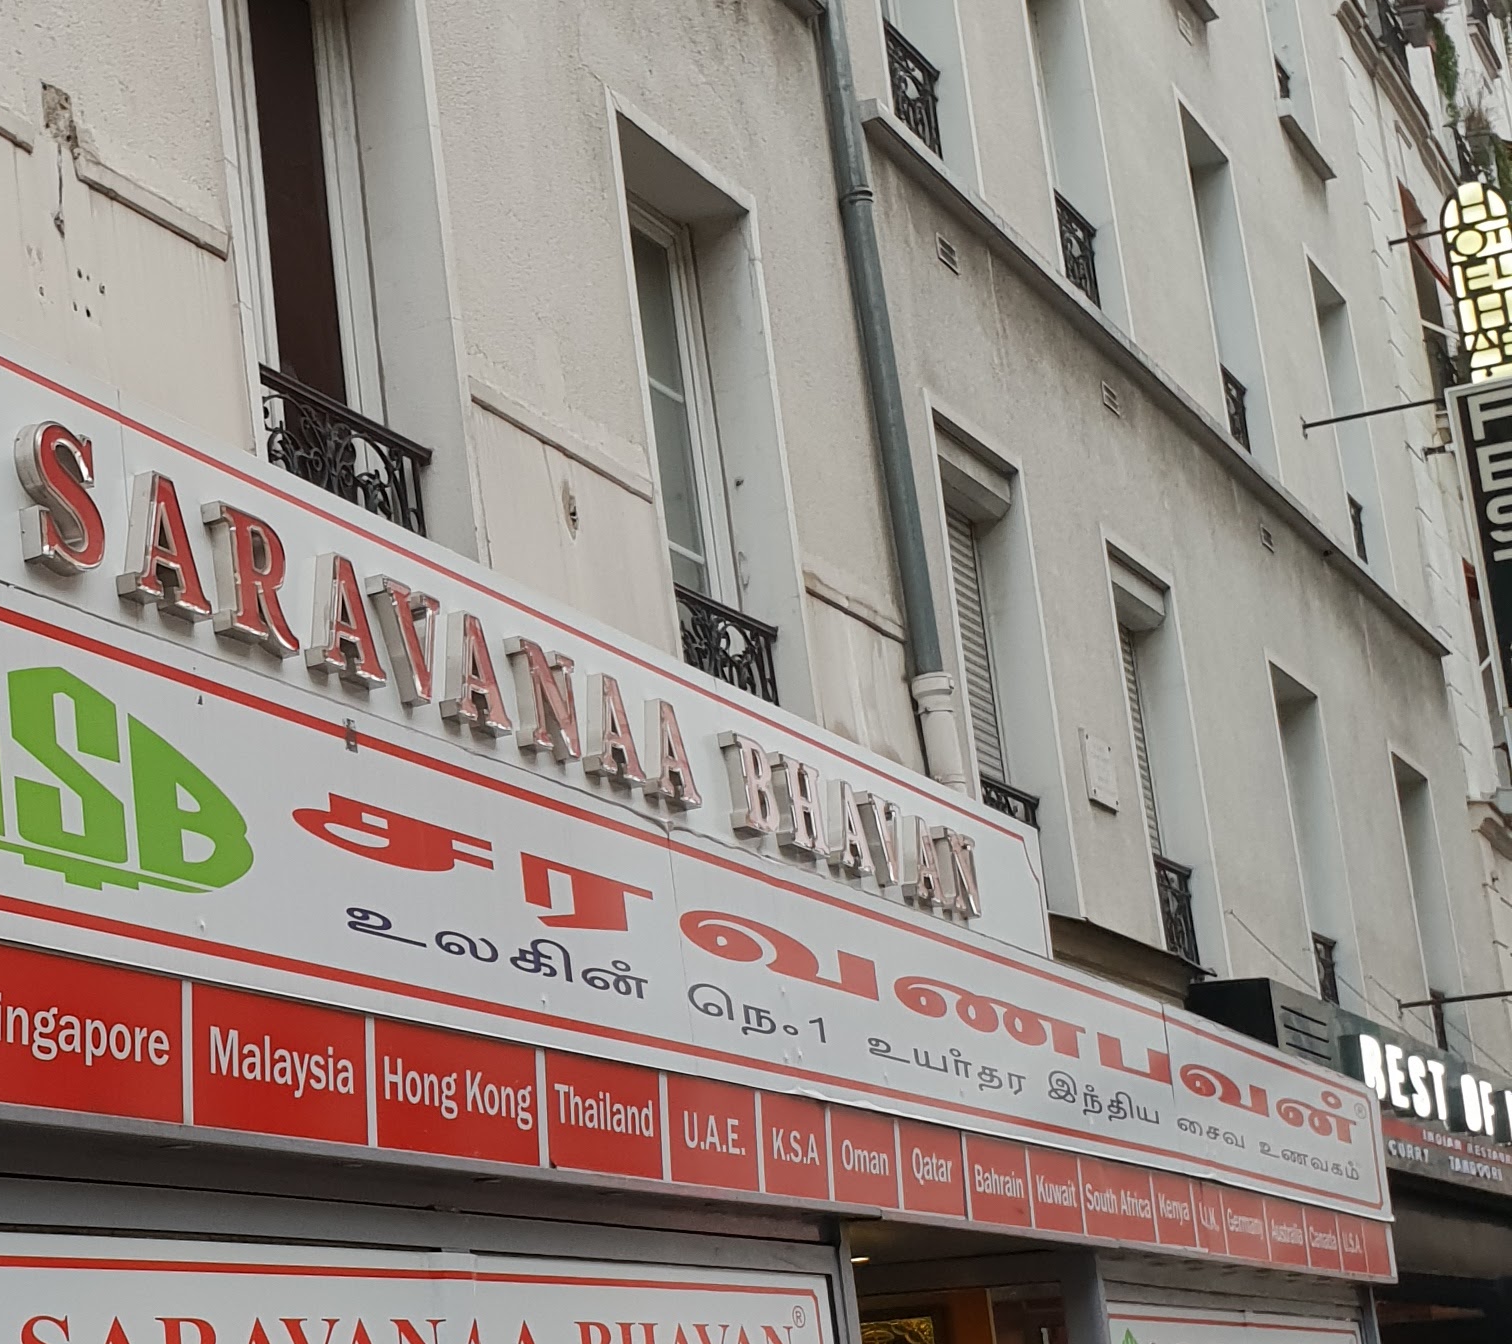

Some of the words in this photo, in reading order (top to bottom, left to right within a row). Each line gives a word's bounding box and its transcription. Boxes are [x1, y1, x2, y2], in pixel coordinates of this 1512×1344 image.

[14, 419, 702, 809] SARAVANAA
[717, 730, 982, 919] BHAVAN
[345, 906, 650, 1000] உலகின்
[208, 1025, 355, 1099] Malaysia
[383, 1055, 458, 1120] Hong
[465, 1070, 533, 1131] Kong
[554, 1083, 654, 1138] Thailand
[683, 1109, 747, 1156] U.A.E.
[772, 1126, 821, 1167] K.S.A
[841, 1139, 889, 1176] Oman
[912, 1147, 953, 1186] Qatar
[974, 1163, 1025, 1199] Bahrain
[1036, 1174, 1078, 1208] Kuwait
[1085, 1182, 1118, 1215] South
[1119, 1189, 1152, 1220] Africa
[1157, 1192, 1190, 1226] Kenya
